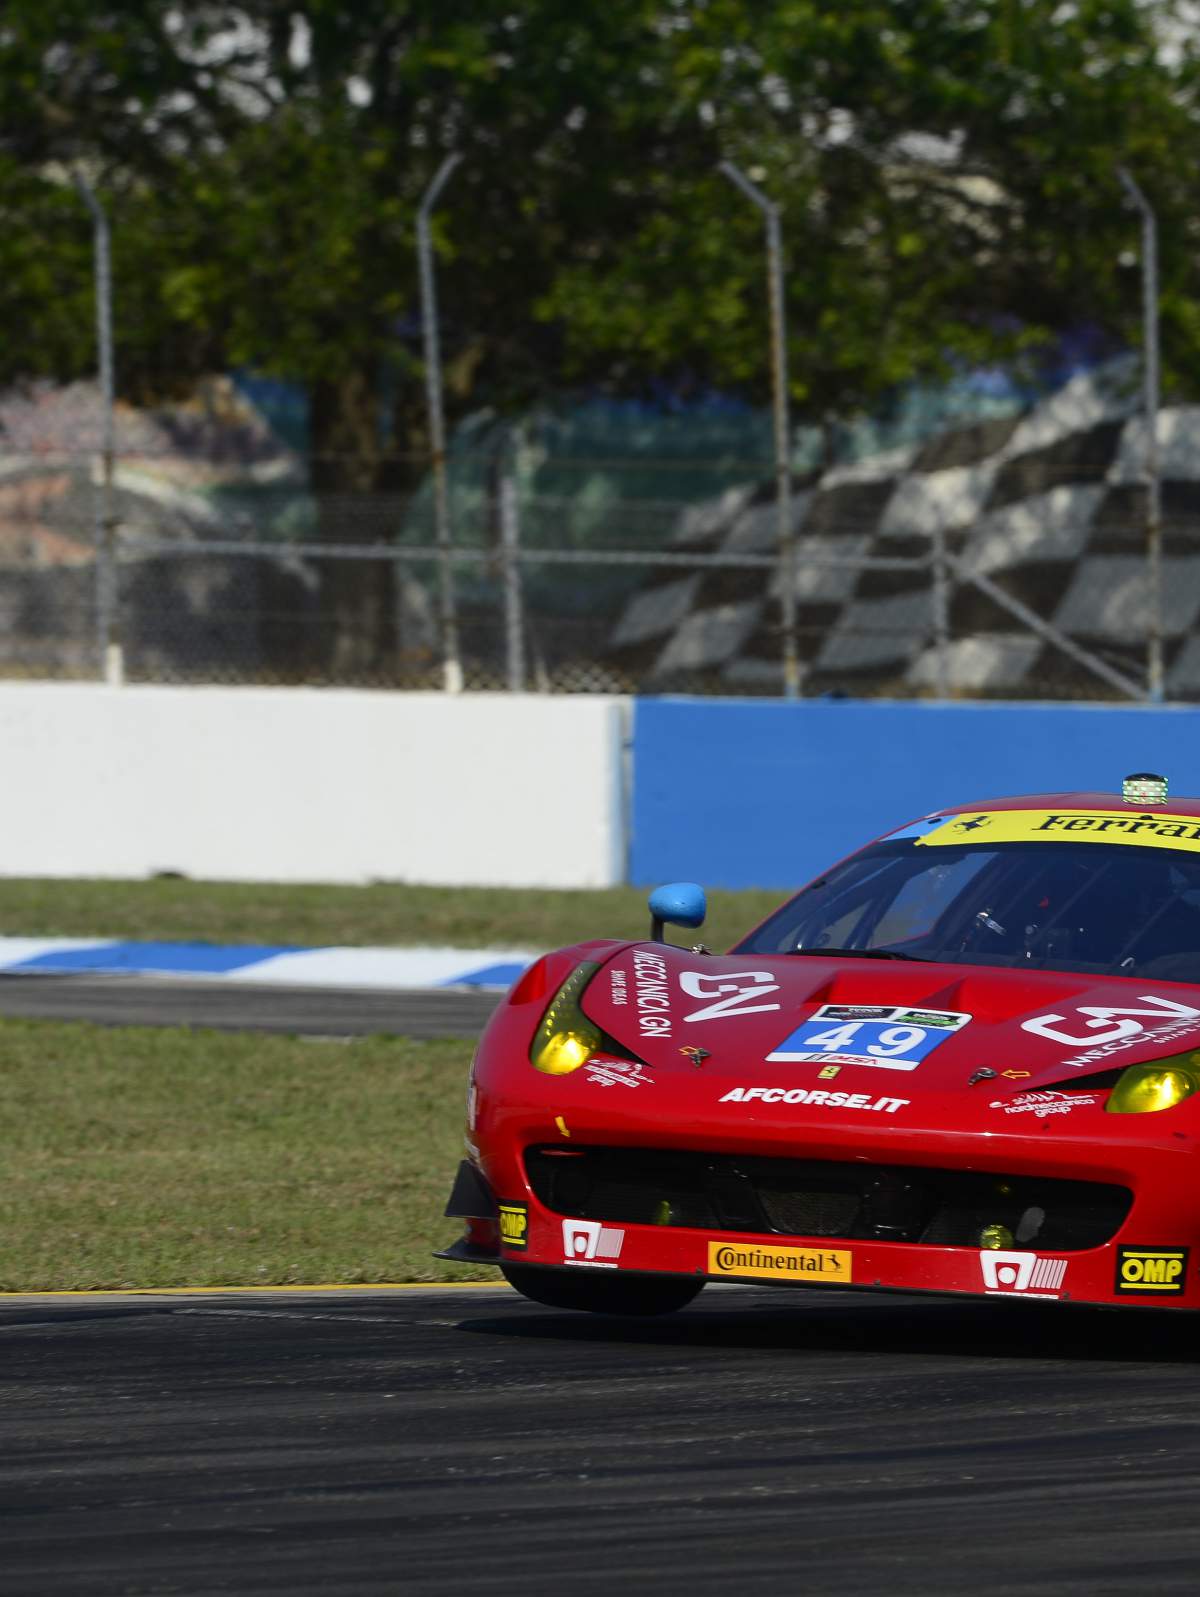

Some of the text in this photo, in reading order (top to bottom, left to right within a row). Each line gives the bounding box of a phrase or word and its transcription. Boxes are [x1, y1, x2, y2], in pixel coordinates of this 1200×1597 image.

[633, 950, 673, 1038] MECCANICA GN
[803, 1022, 929, 1057] 49
[718, 1087, 911, 1113] AFCORSE.IT
[500, 1213, 527, 1238] OMP
[715, 1246, 824, 1273] Continental
[1121, 1258, 1183, 1283] OMP
